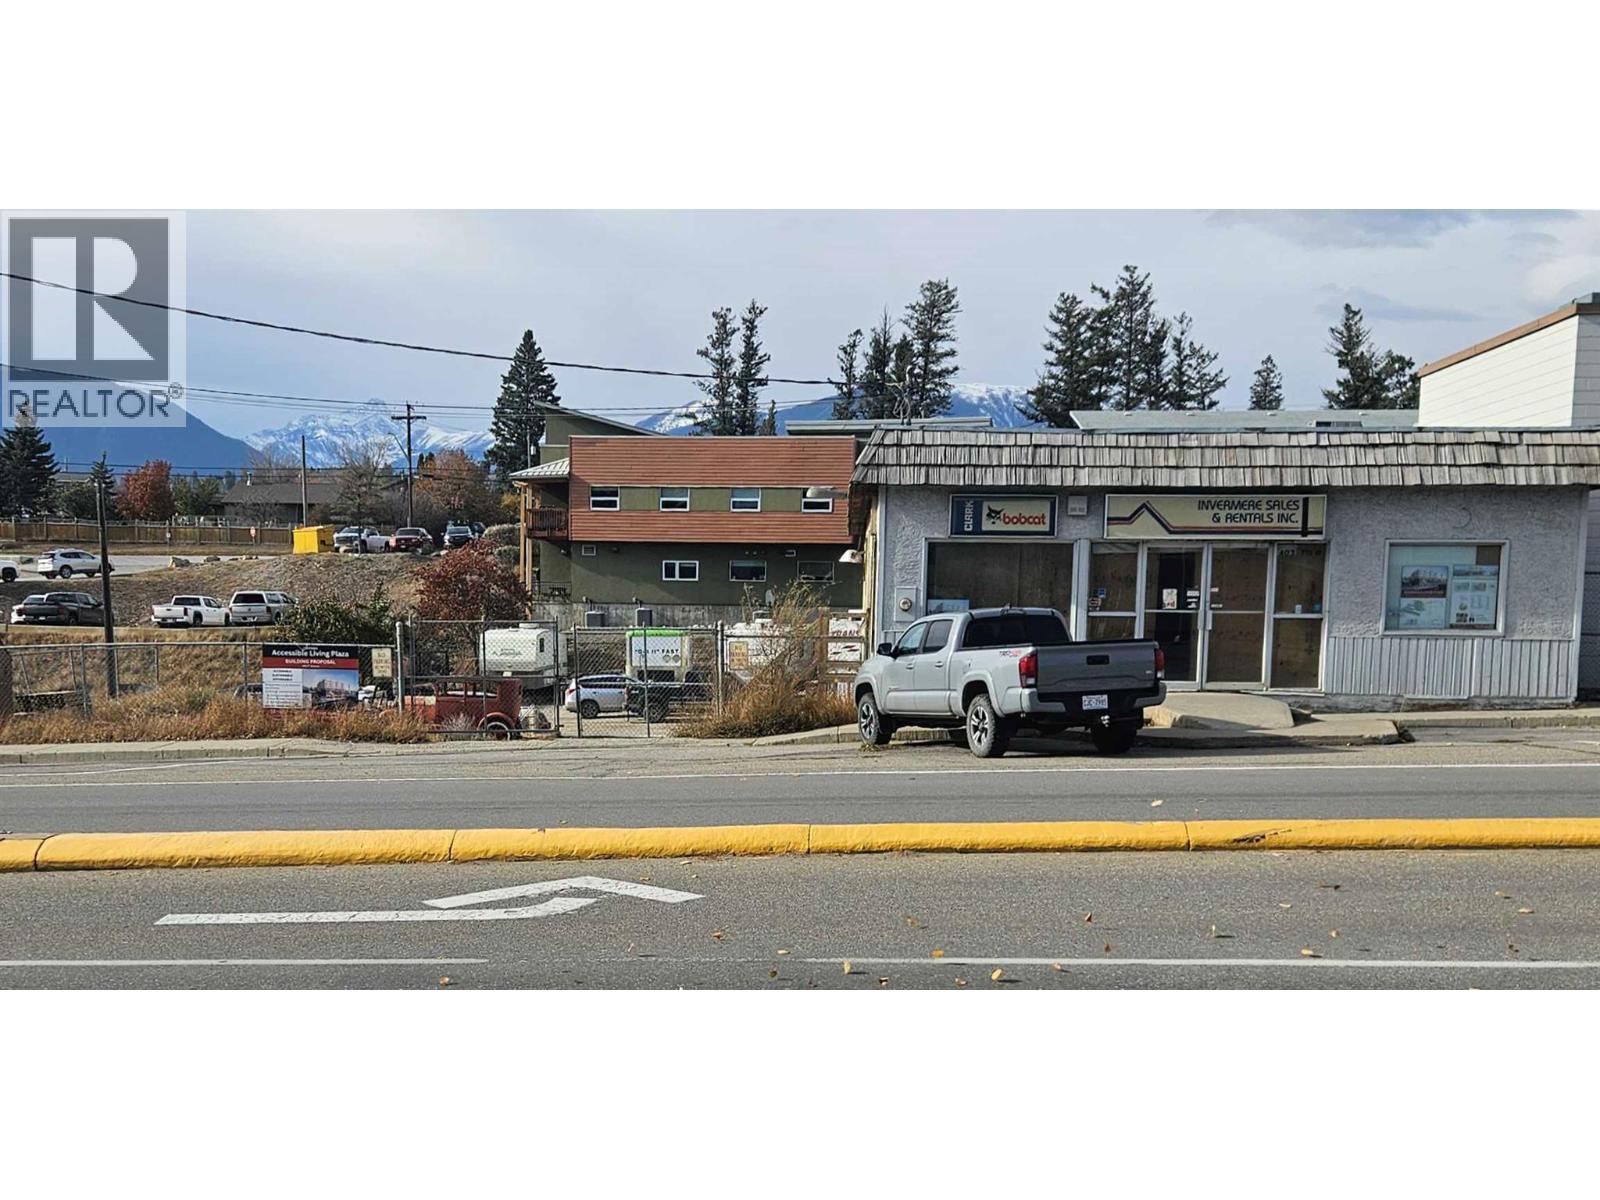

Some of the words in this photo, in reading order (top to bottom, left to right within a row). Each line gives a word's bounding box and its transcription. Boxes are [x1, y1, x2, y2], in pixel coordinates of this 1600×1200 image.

[1197, 499, 1263, 511] INVERMERE
[1265, 499, 1300, 511] SALES
[963, 500, 974, 532] CLARK
[1002, 512, 1047, 526] bobcat
[1211, 512, 1222, 524] &
[1224, 512, 1274, 524] RENTALS
[1277, 512, 1299, 524] INC.
[271, 649, 309, 657] Accessible
[309, 649, 330, 658] Living
[331, 650, 350, 658] Plaza
